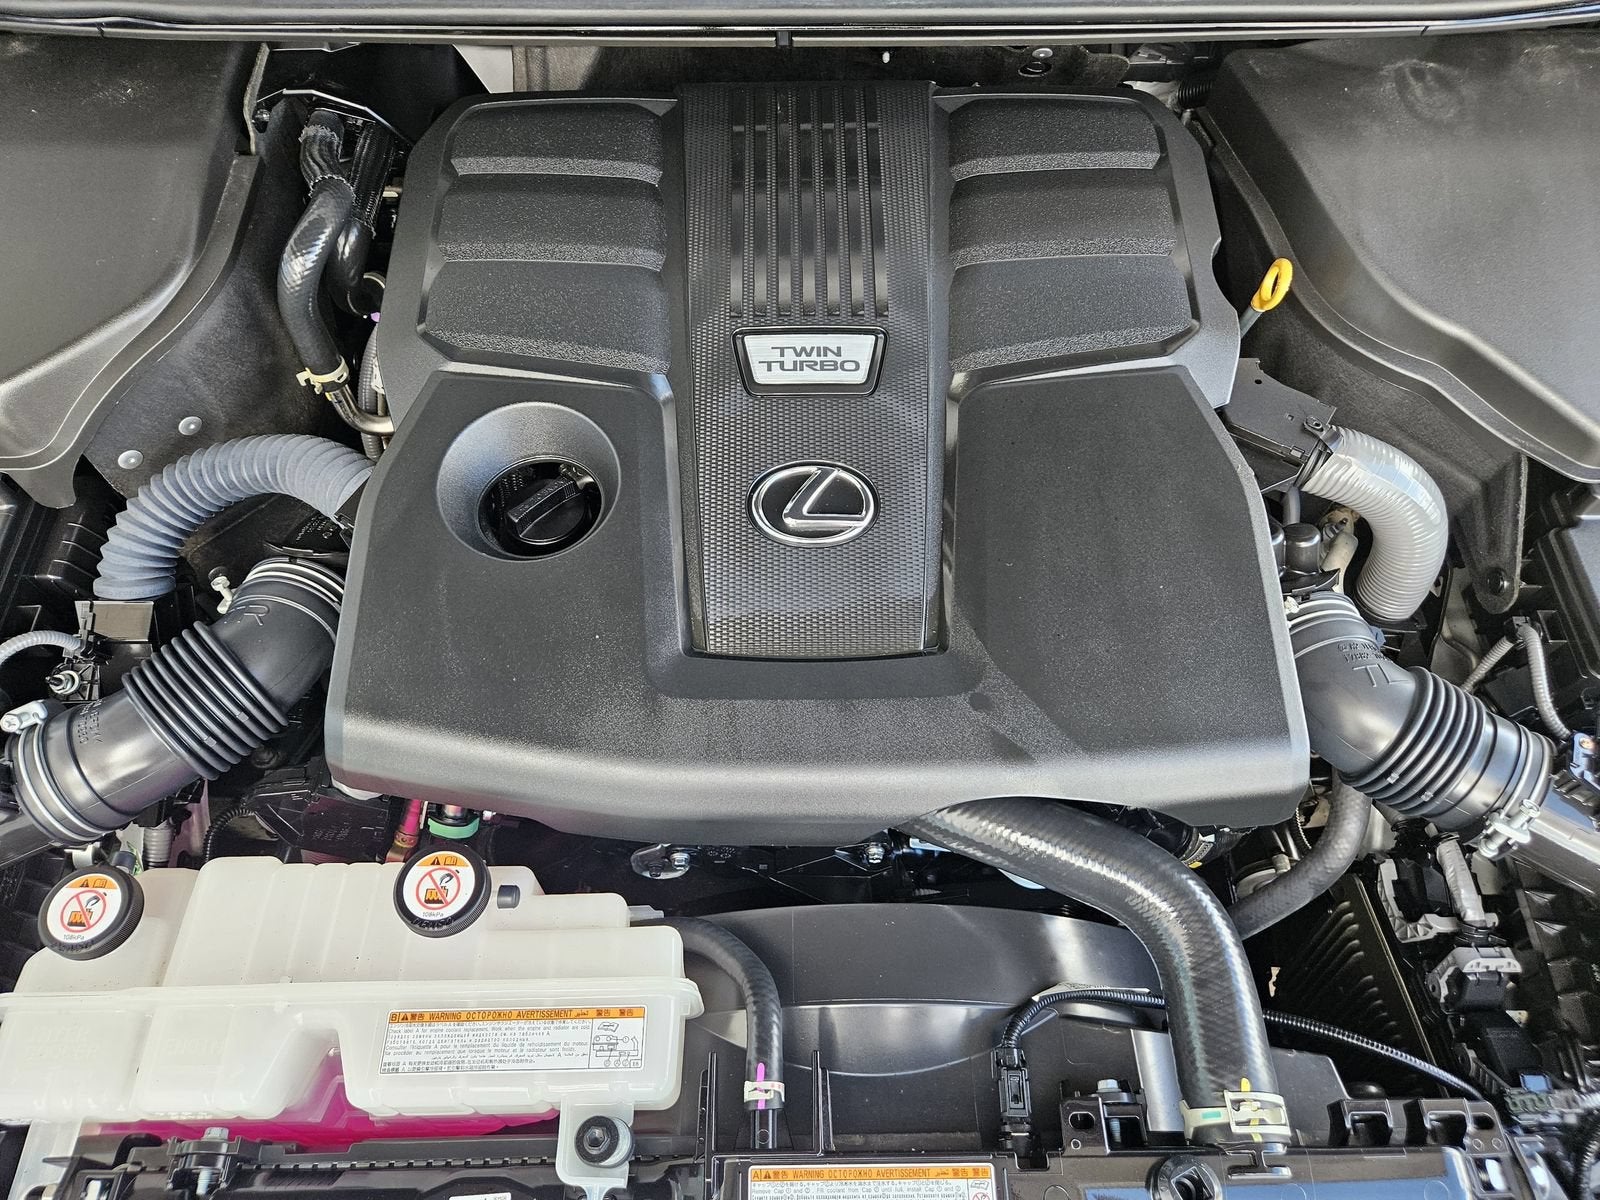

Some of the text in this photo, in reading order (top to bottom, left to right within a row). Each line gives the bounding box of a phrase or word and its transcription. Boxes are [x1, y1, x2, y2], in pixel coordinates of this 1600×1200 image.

[771, 346, 842, 358] TWIN
[758, 360, 861, 372] TURBO
[429, 1012, 462, 1020] WARNING
[516, 1009, 572, 1019] AVERTISSEMENT
[752, 1171, 760, 1179] A
[793, 1169, 825, 1179] WARNING
[876, 1168, 931, 1178] AVERTISSEMENT
